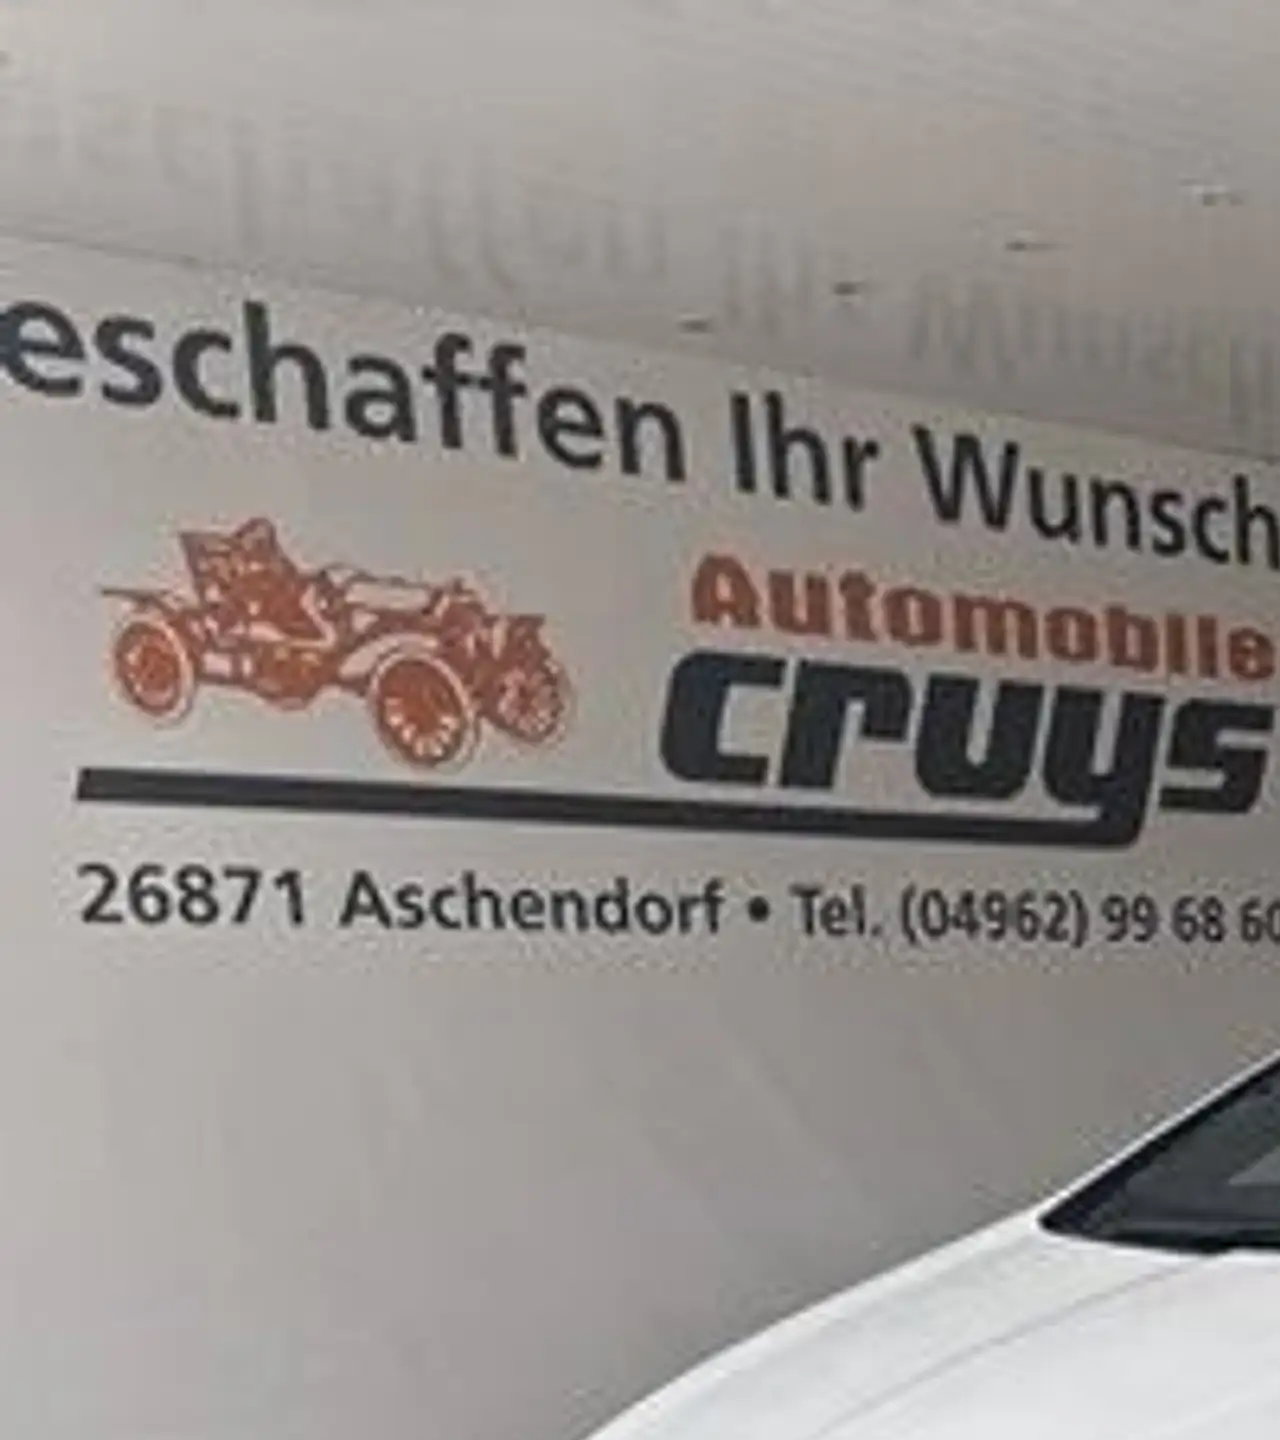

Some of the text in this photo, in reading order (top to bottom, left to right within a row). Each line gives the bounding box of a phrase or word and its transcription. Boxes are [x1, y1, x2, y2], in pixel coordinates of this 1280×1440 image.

[731, 391, 881, 511] Ihr
[690, 553, 1278, 684] Automobile
[79, 863, 305, 926] 26871
[339, 871, 726, 936] Aschendorf
[791, 884, 883, 937] Tel.
[900, 885, 1089, 949] (04962)
[1101, 895, 1159, 944] 99
[1173, 896, 1227, 944] 68
